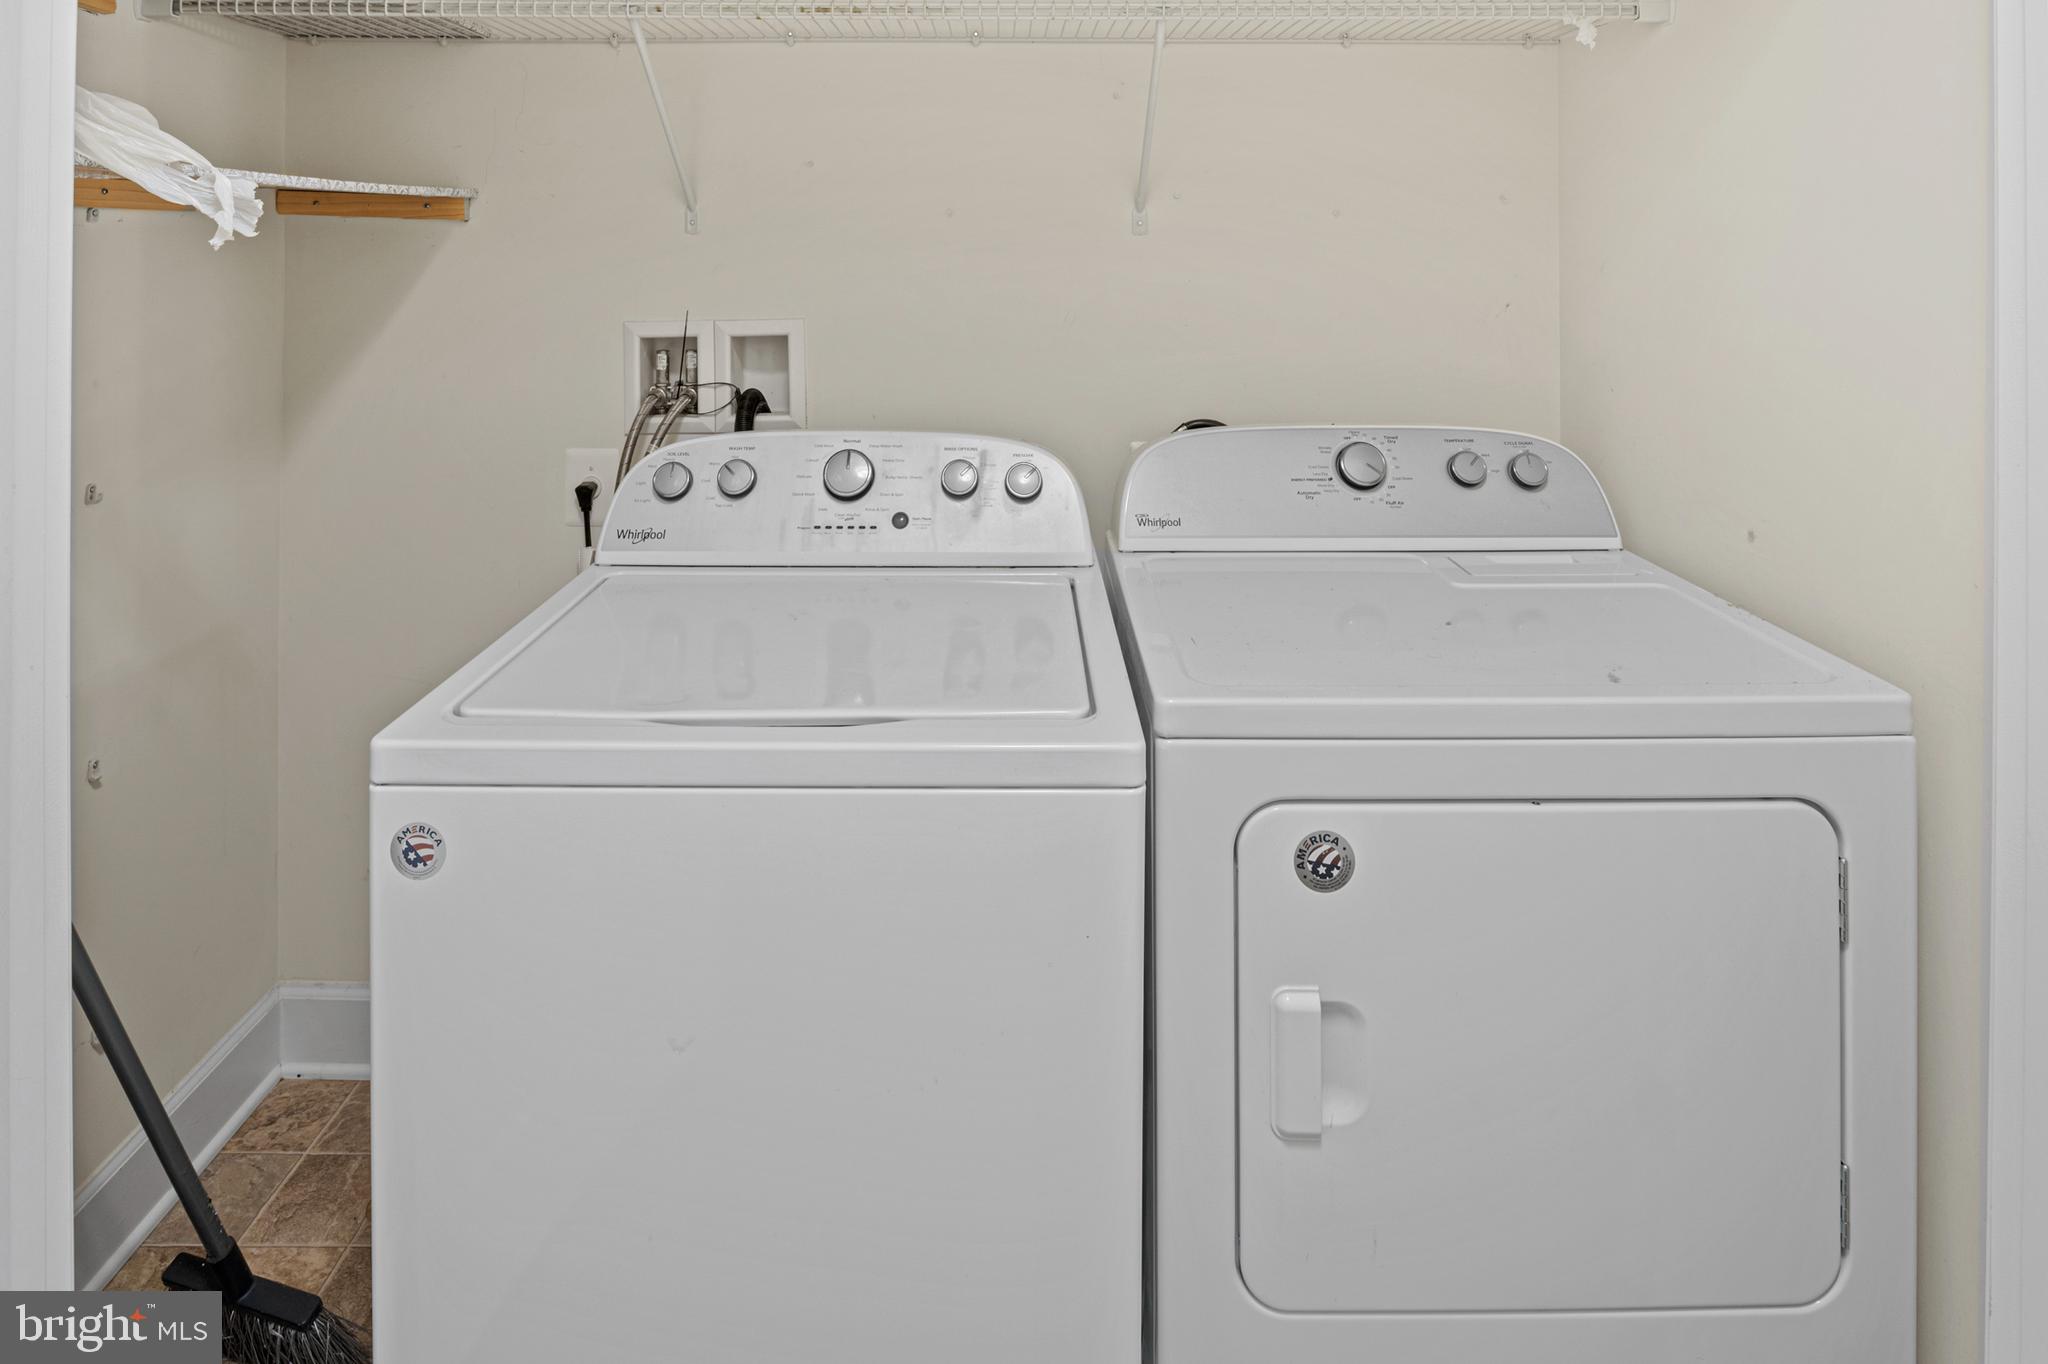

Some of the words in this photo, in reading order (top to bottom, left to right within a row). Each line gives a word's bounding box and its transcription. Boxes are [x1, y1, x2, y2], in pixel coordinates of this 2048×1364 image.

[1136, 517, 1181, 529] Whirlpool
[616, 528, 667, 544] Whirlpool
[397, 825, 442, 847] AMERICA
[1297, 833, 1339, 870] AMERICA
